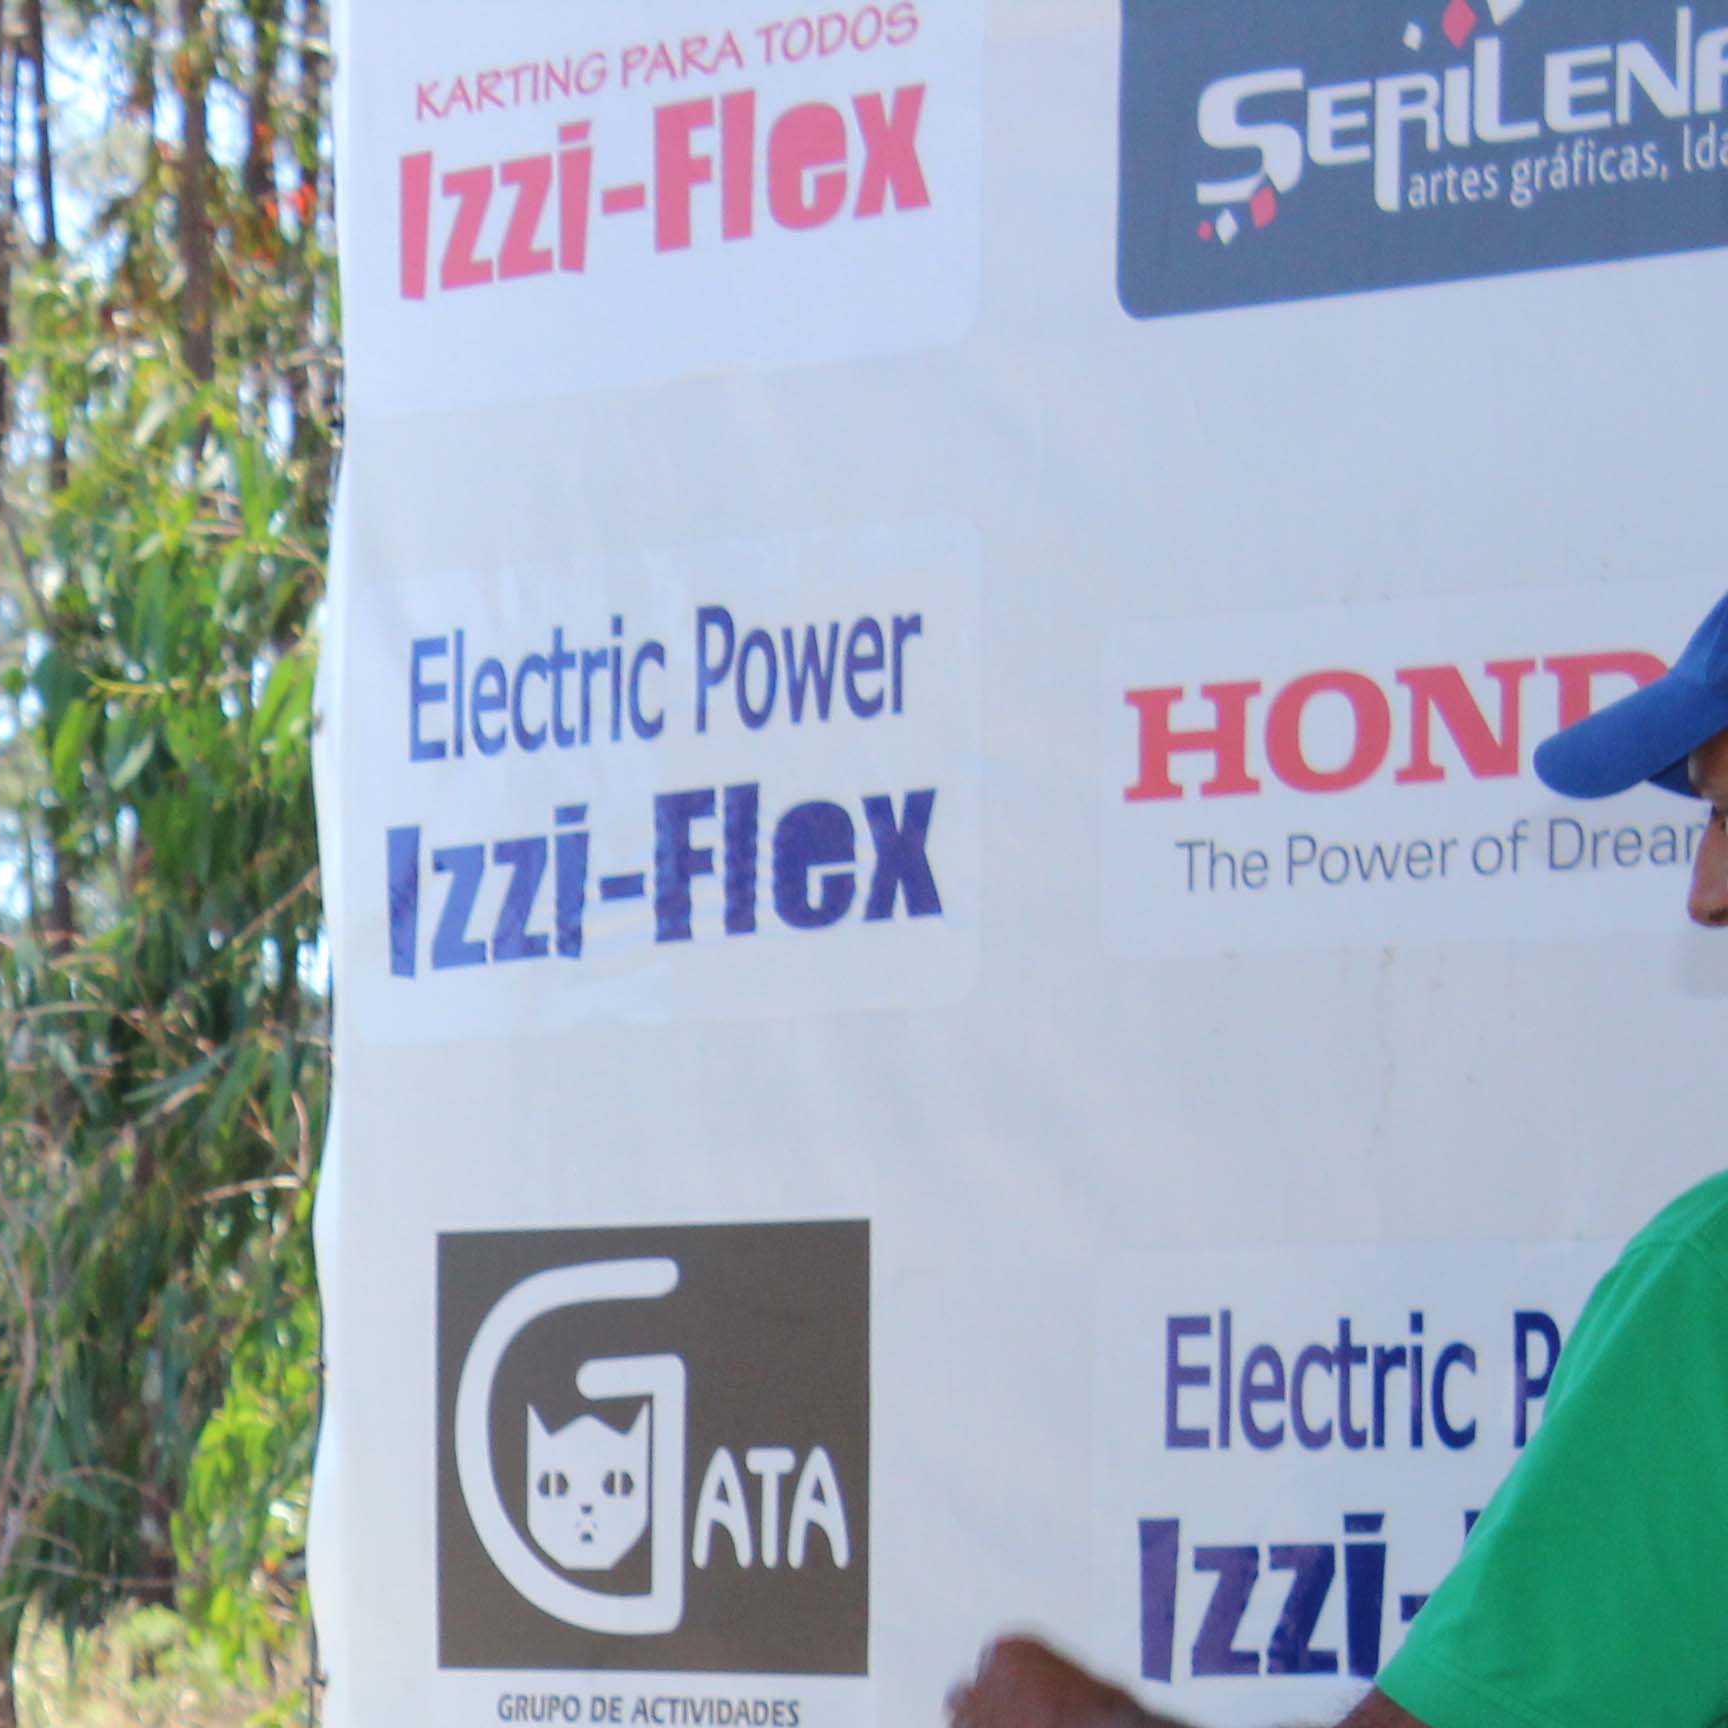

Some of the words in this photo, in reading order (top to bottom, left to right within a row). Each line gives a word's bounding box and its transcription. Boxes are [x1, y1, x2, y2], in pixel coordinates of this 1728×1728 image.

[415, 52, 608, 122] KARTING
[620, 29, 744, 88] PARA
[756, 1, 920, 66] TODOS
[399, 82, 931, 300] Izzi-Flex
[1407, 162, 1498, 210] artes
[1509, 138, 1669, 209] gráficas,
[408, 613, 666, 763] Electric
[695, 603, 922, 734] Power
[386, 781, 943, 979] Izzi-Flex
[1175, 837, 1270, 892] The
[1286, 832, 1458, 888] Power
[1470, 820, 1531, 878] of
[1164, 1307, 1477, 1452] Electric
[496, 1693, 582, 1724] GRUPO
[589, 1695, 624, 1724] DE
[630, 1695, 801, 1728] ACTIVIDADES
